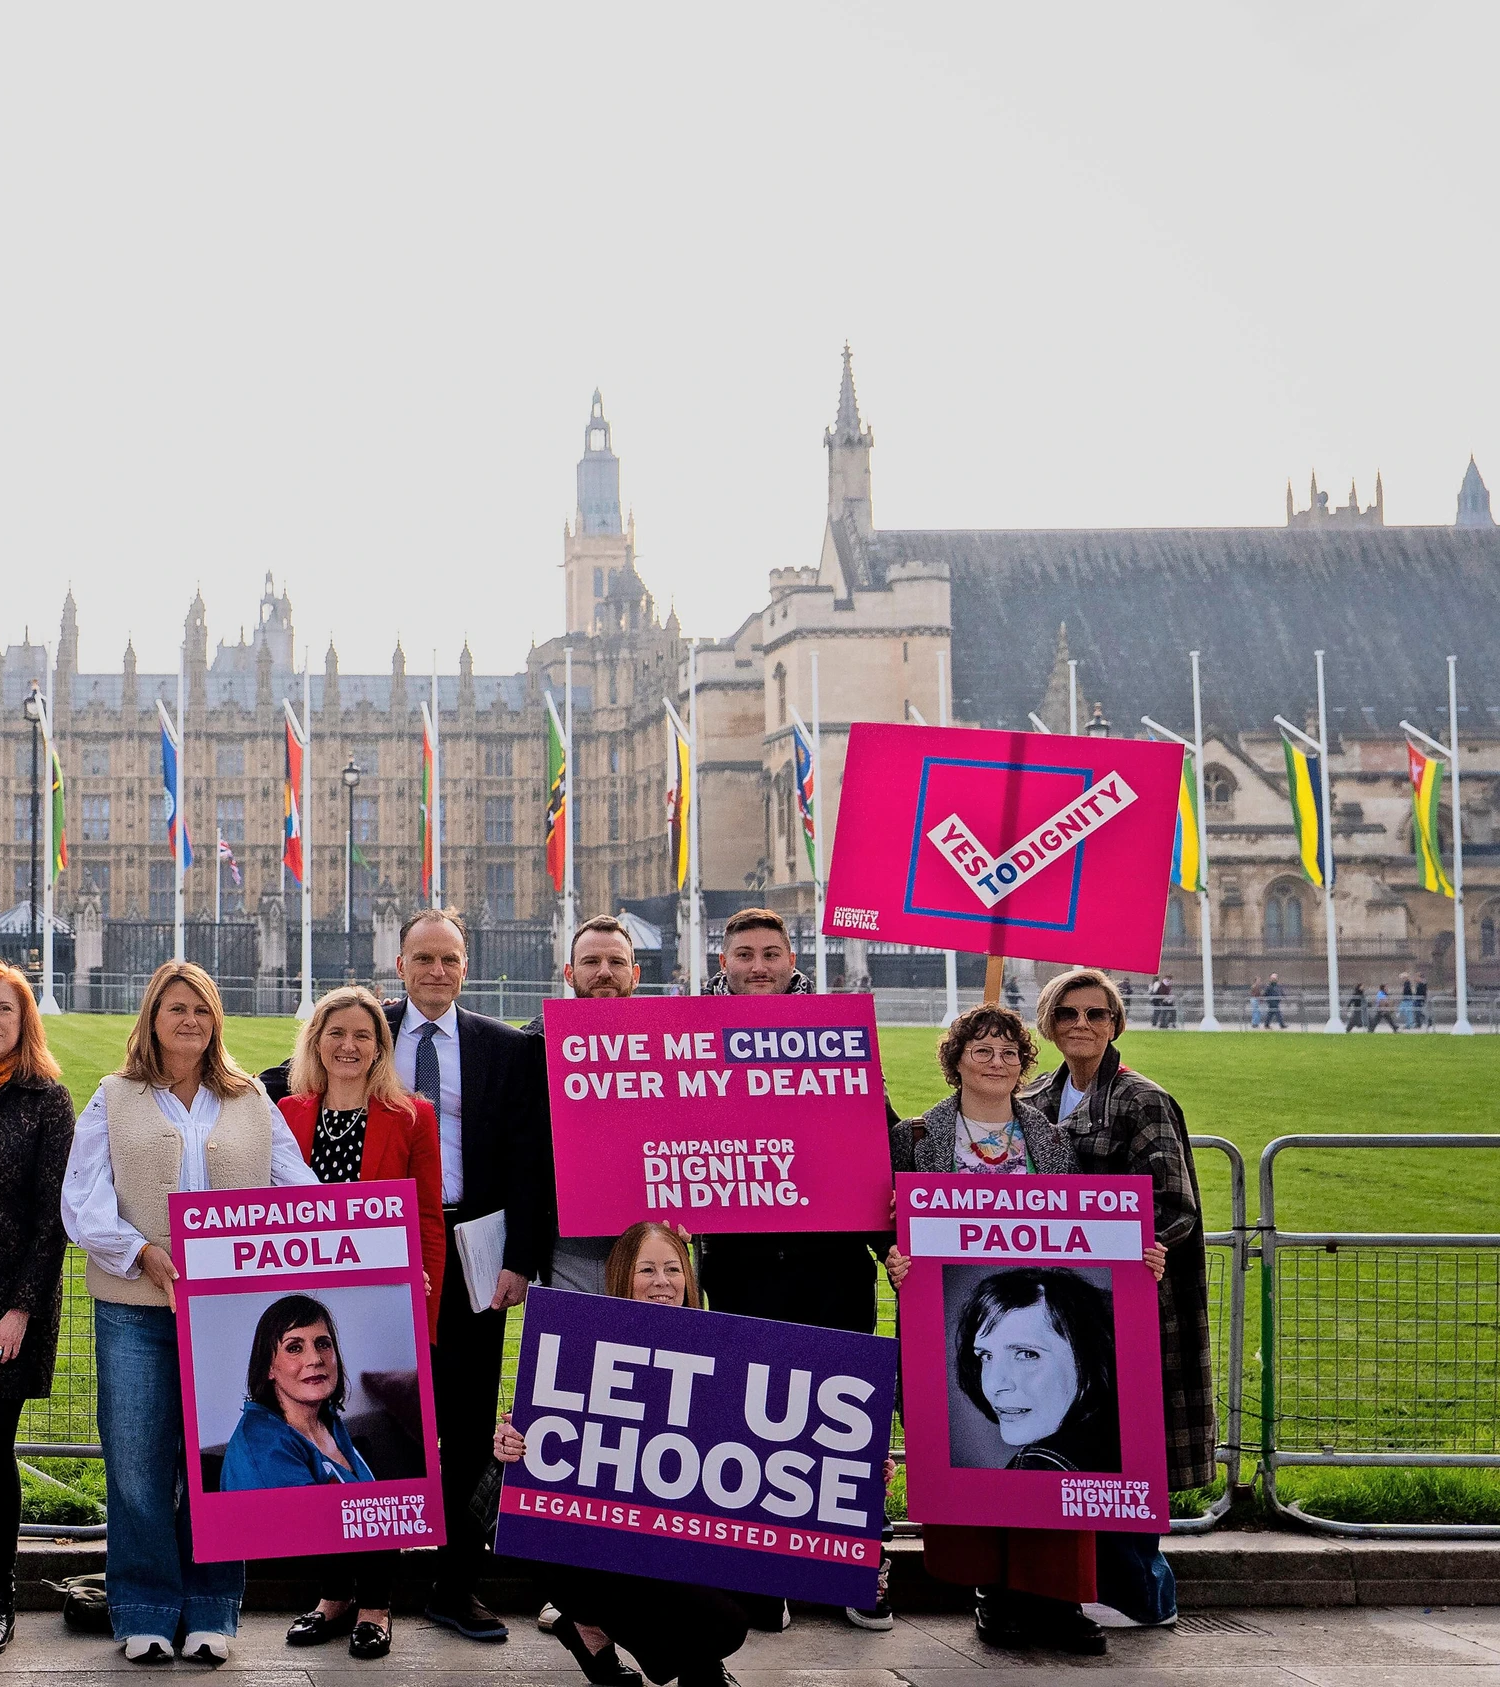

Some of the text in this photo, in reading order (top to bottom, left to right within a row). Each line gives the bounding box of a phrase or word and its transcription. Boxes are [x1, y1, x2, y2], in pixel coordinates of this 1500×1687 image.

[939, 822, 988, 877] YES
[833, 919, 880, 930] IN DYING.
[834, 911, 878, 923] DIGNITY
[562, 1030, 866, 1063] GIVE ME CHOICE
[564, 1068, 869, 1101] OVER MY DEATH
[643, 1139, 795, 1155] CAMPAIGN FOR
[643, 1155, 796, 1182] DIGNITY
[646, 1181, 810, 1208] IN DYING.
[909, 1187, 1140, 1213] CAMPAIGN FOR
[183, 1196, 404, 1230] CAMPAIGN FOR
[959, 1224, 1093, 1253] PAOLA
[232, 1235, 361, 1271] PAOLA
[531, 1332, 876, 1452] LET US
[523, 1415, 872, 1528] CHOOSE
[1061, 1479, 1149, 1490] CAMPAIGN FOR
[341, 1494, 425, 1509] CAMPAIGN FOR
[1061, 1487, 1150, 1505] DIGNITY
[342, 1504, 425, 1523] DIGNITY
[1062, 1502, 1157, 1520] IN DYING.
[343, 1519, 433, 1538] IN DYING.
[519, 1493, 866, 1560] LEGALISE ASSISTED DYING
